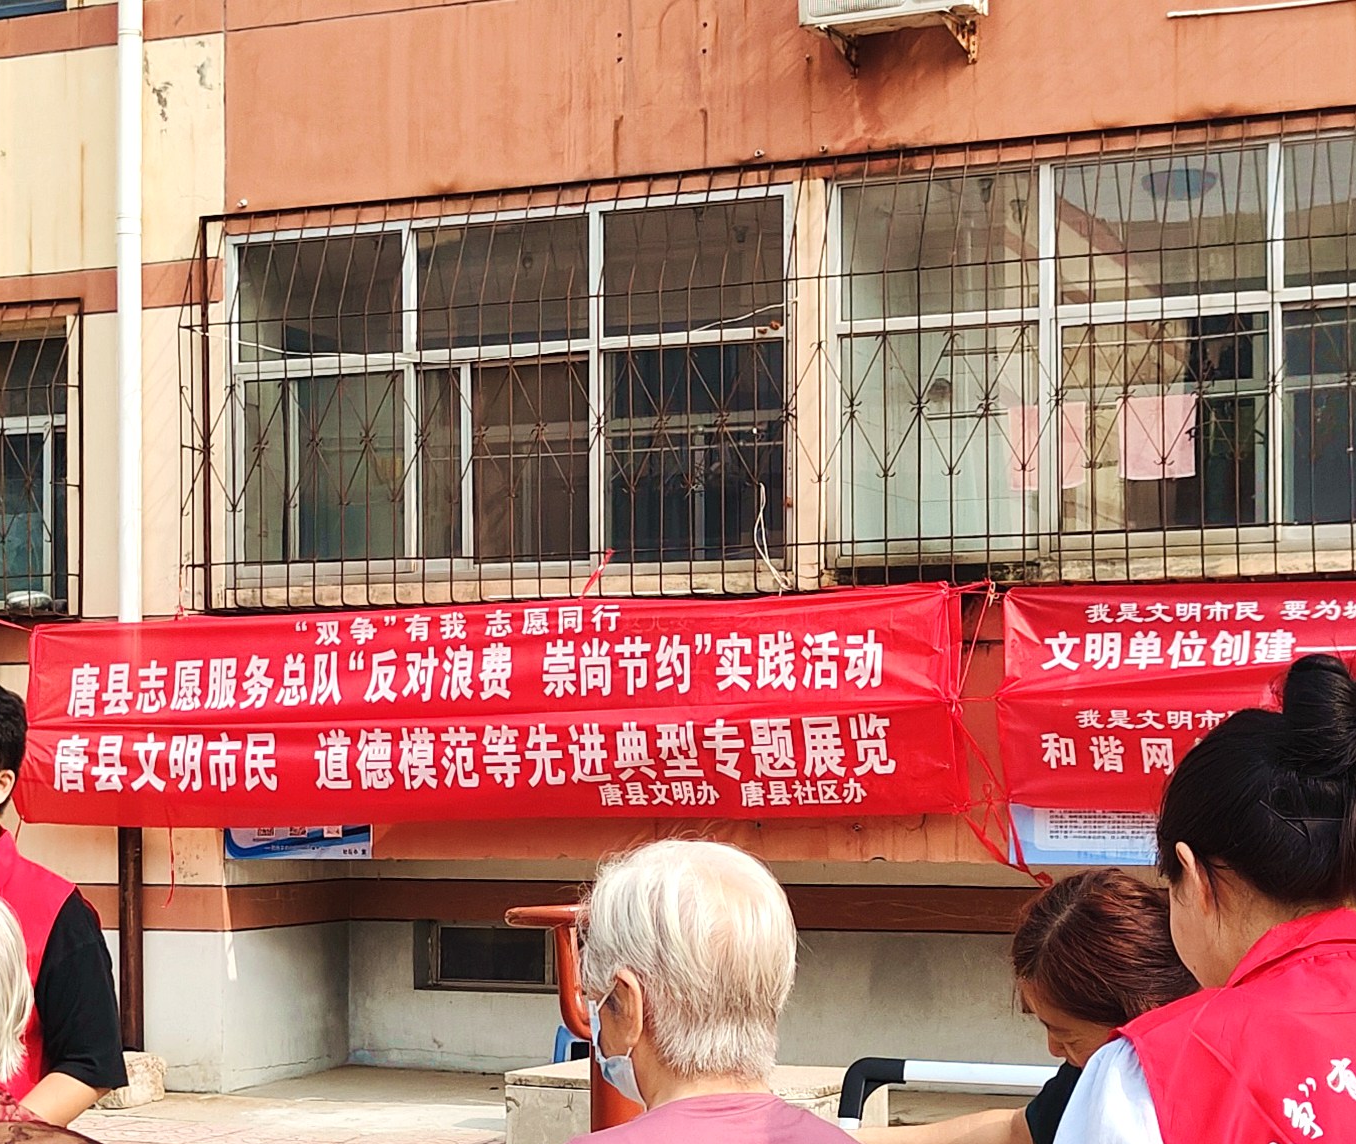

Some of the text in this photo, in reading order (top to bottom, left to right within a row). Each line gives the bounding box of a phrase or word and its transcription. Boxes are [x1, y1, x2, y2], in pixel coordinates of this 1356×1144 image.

[295, 603, 622, 646] “双争”有我 志愿同行
[1085, 600, 1265, 624] 我是文明市民
[543, 628, 884, 699] 崇尚节约”实践活动
[1075, 708, 1237, 731] 我是文明市
[53, 713, 897, 793] 唐县文明市民 道德模范等先进典型专题展览
[1041, 733, 1203, 776] 和谐网
[599, 780, 869, 808] 唐县文明办 唐县社区办
